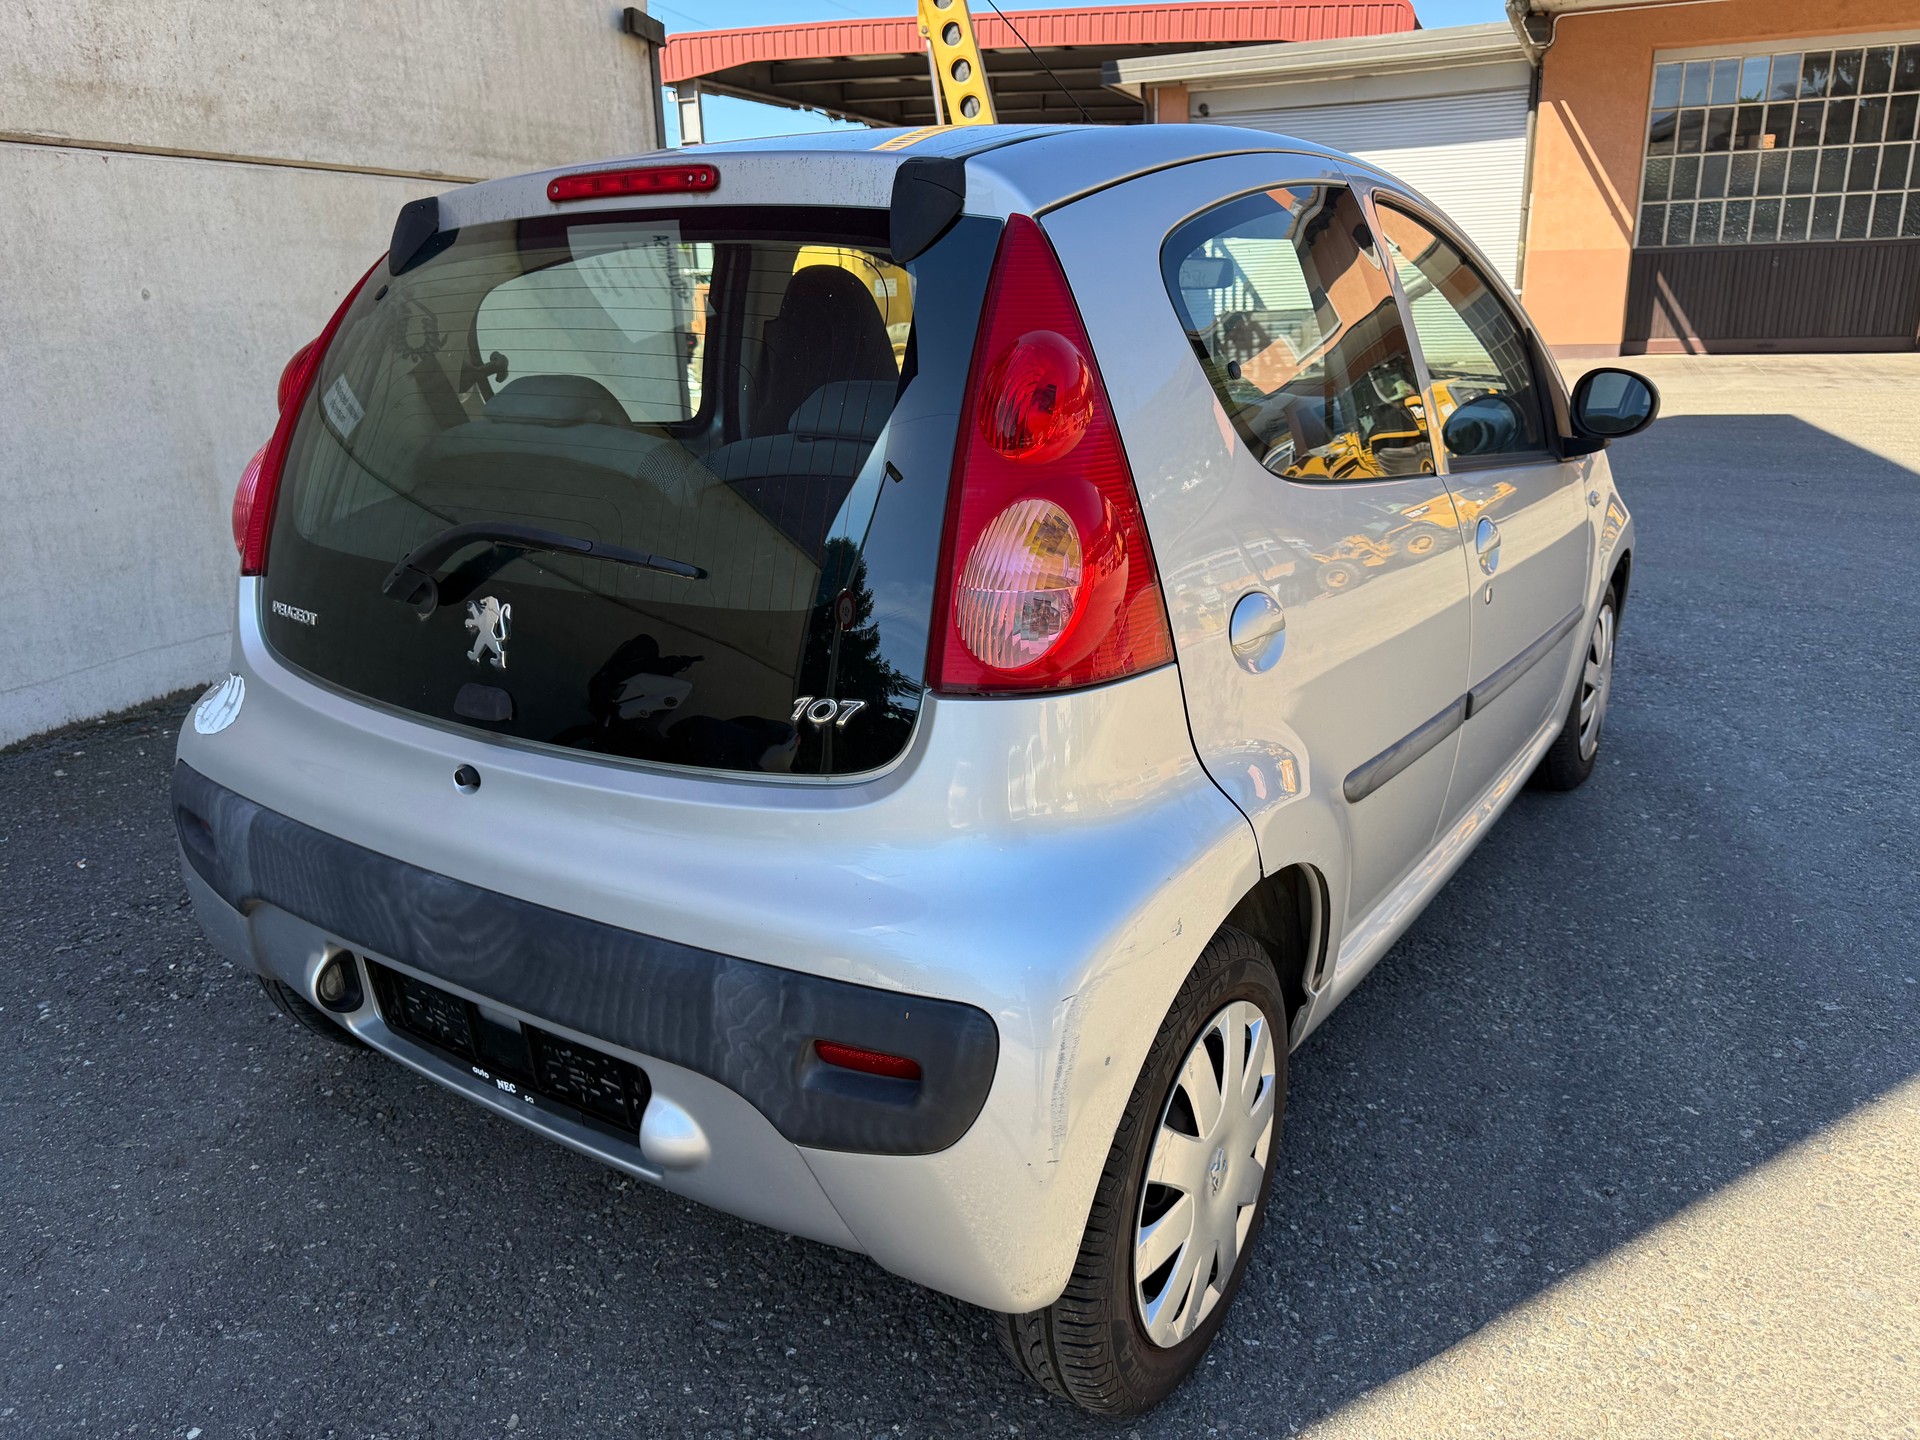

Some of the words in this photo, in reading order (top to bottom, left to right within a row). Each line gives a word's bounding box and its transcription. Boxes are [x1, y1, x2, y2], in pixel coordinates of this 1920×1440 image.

[272, 600, 318, 626] PEUGEOT
[790, 696, 866, 727] 107
[1162, 969, 1231, 1084] ENERGY
[472, 1066, 490, 1079] auto
[496, 1078, 517, 1094] NEC
[524, 1095, 535, 1105] sa
